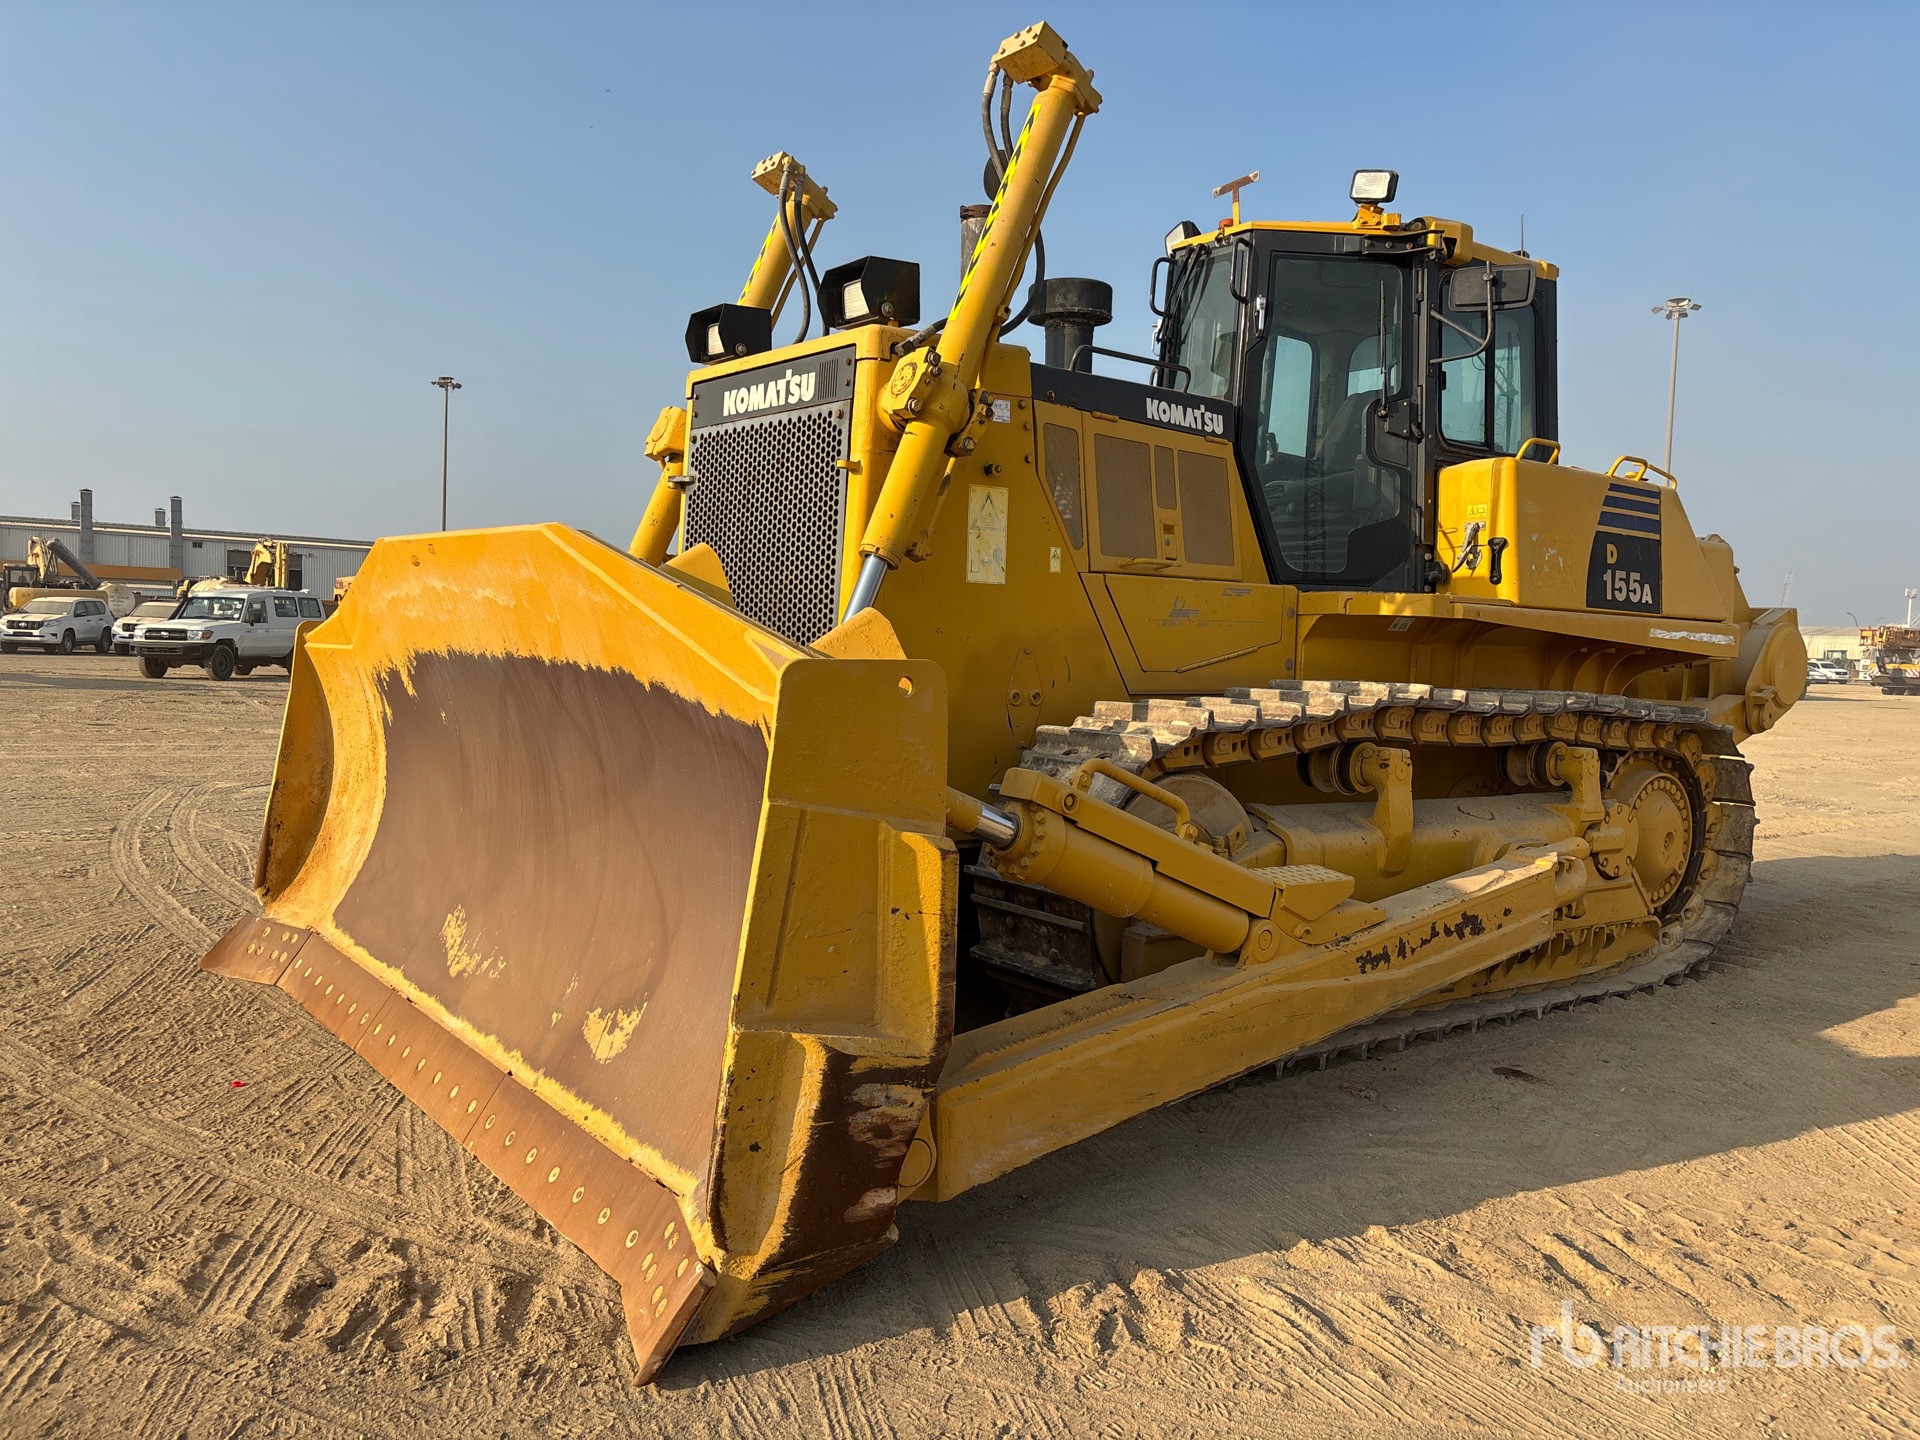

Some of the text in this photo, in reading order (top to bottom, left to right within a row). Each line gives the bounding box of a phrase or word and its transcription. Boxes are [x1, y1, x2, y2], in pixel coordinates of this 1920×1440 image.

[722, 369, 816, 417] KOMATSU
[1145, 397, 1224, 435] KOMATSU
[1606, 543, 1618, 565] D
[1602, 569, 1653, 605] 155A
